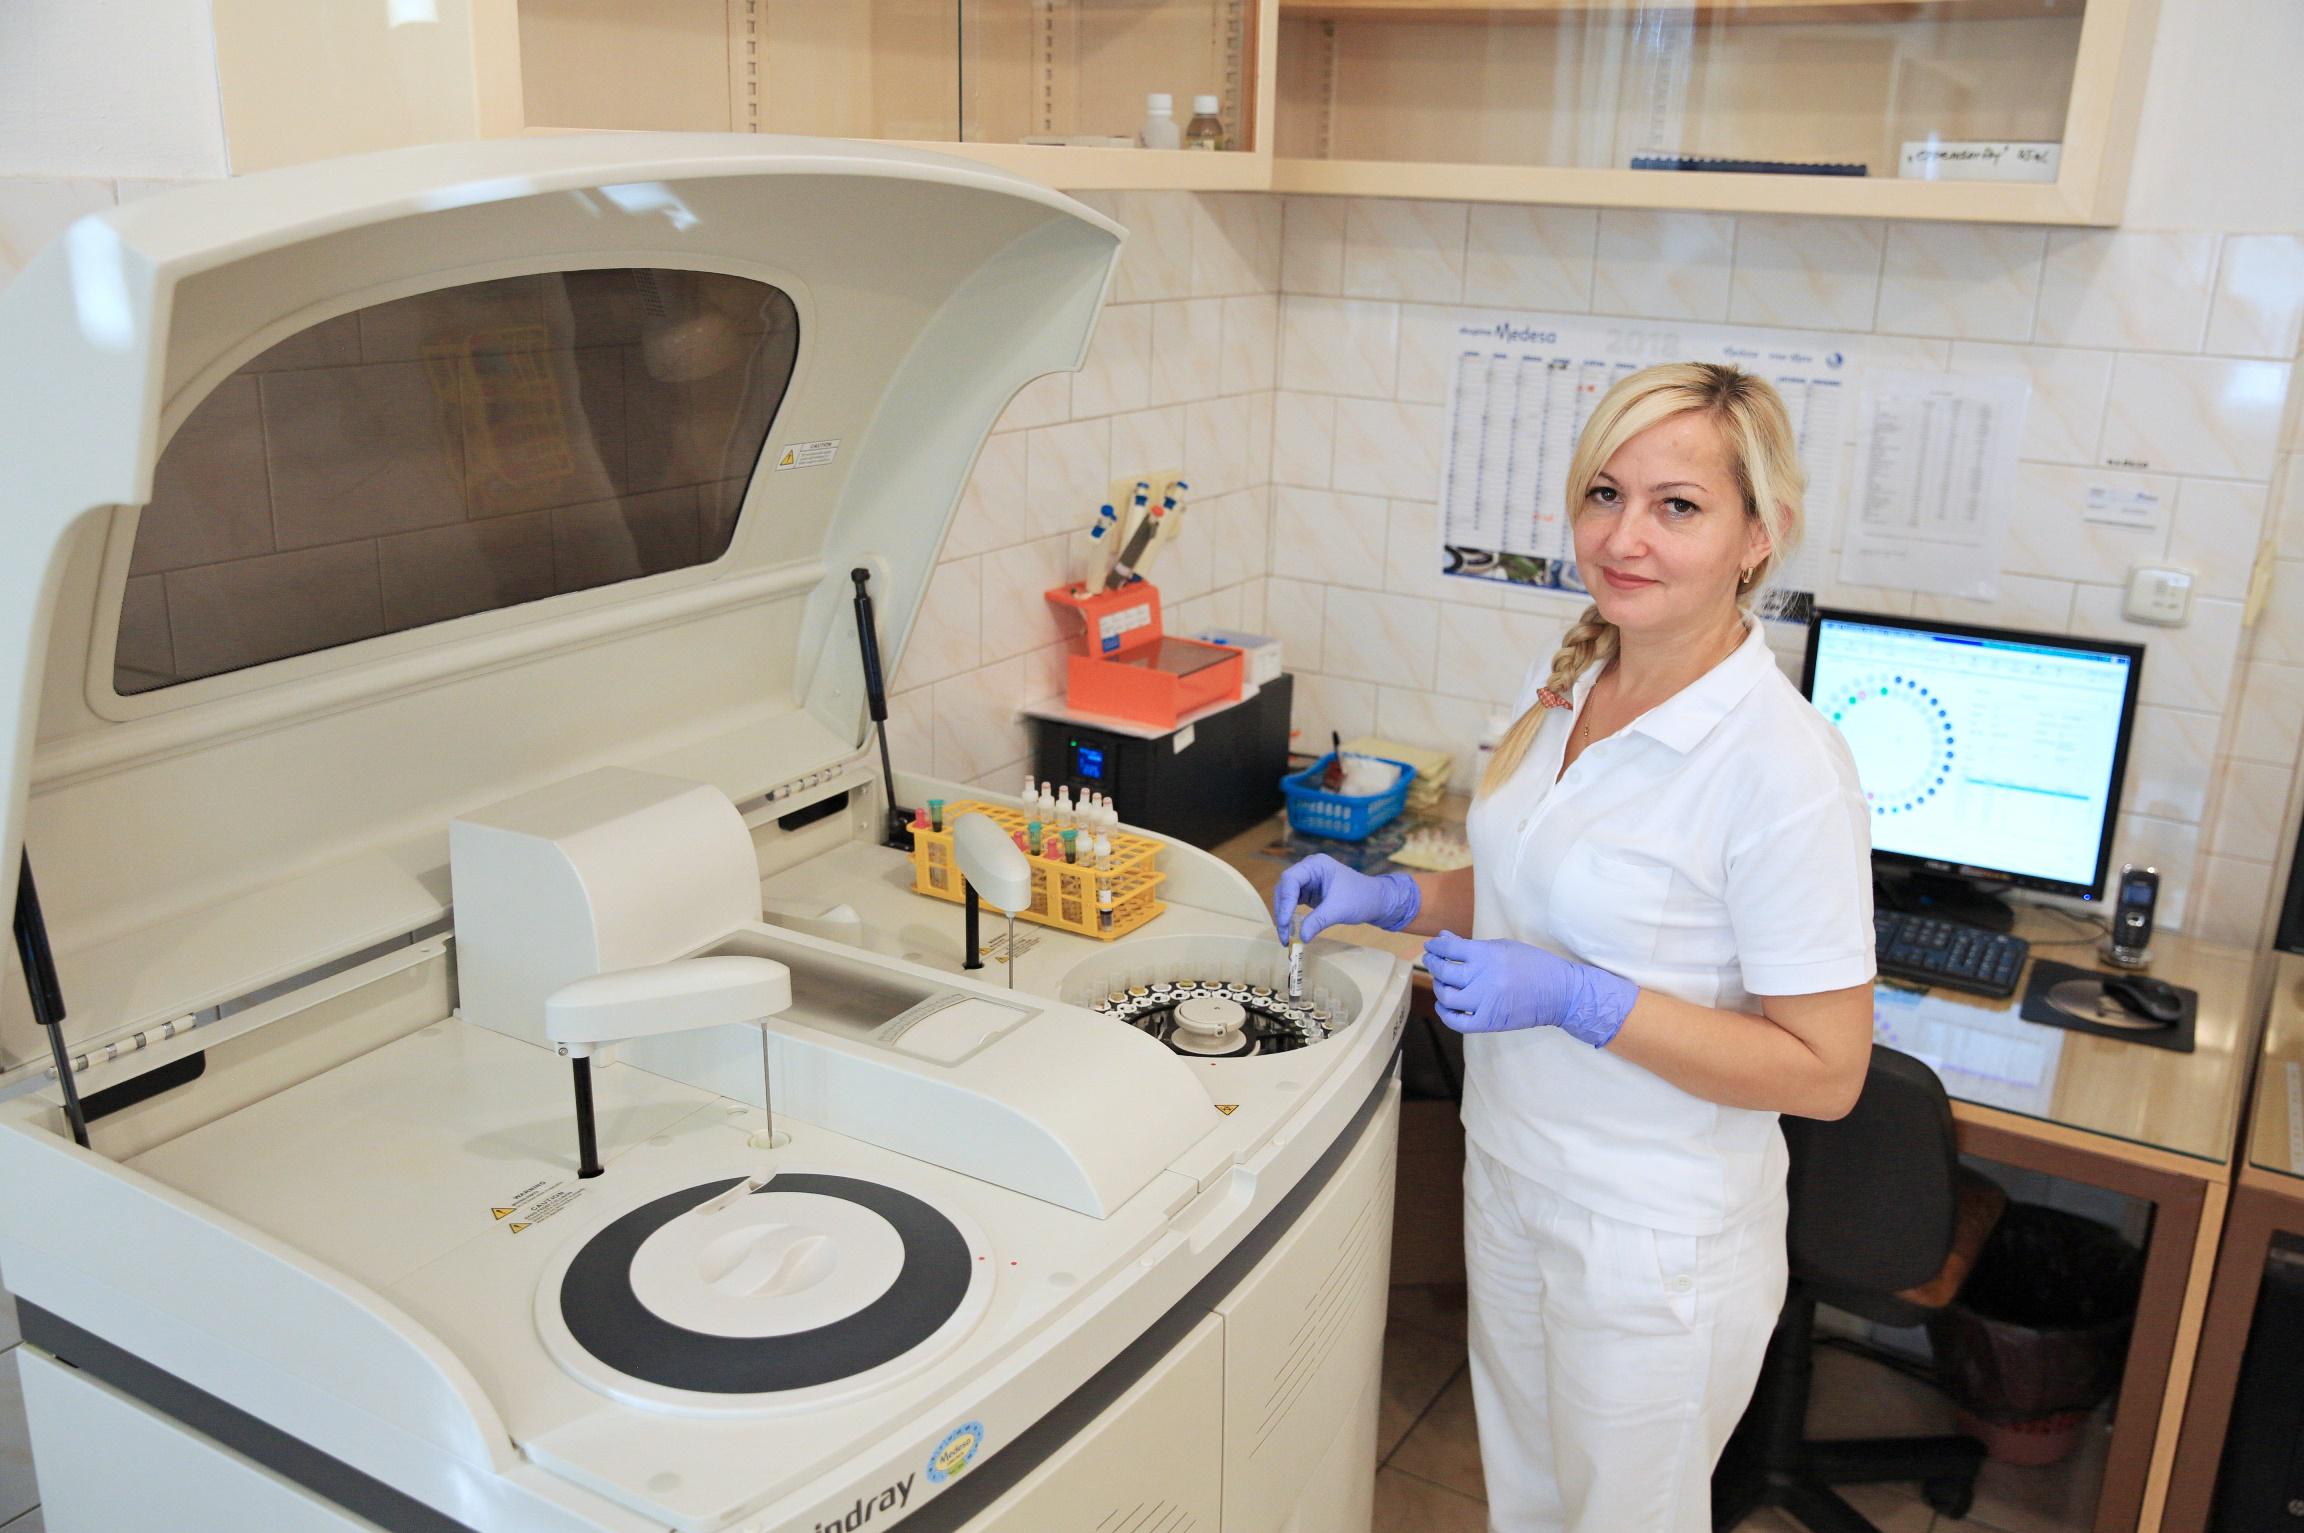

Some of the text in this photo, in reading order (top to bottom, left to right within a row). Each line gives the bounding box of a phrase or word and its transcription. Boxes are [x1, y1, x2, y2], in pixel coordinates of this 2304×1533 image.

[1495, 322, 1557, 344] Medesa
[514, 1180, 547, 1200] WARNING
[530, 1190, 565, 1212] CAUTION
